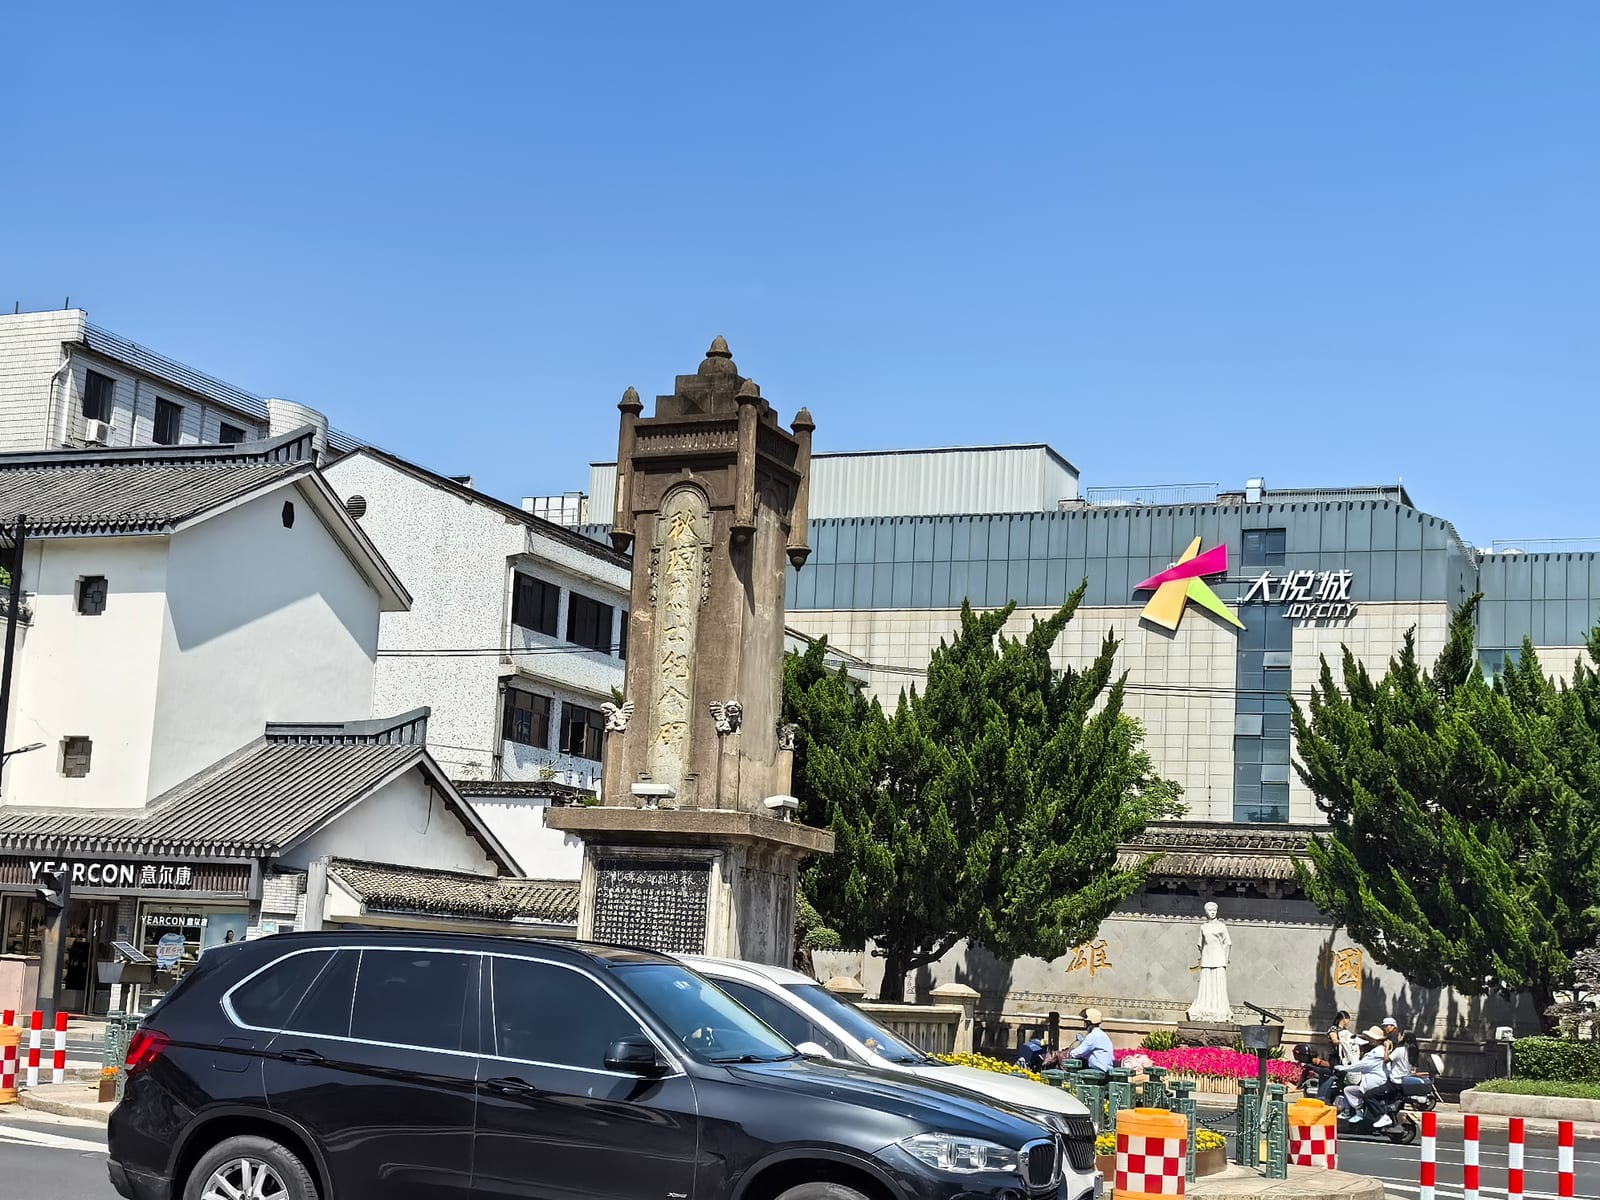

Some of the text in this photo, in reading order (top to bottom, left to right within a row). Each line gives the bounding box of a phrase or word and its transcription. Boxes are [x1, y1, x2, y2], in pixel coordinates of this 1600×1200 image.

[1243, 569, 1353, 602] 大悦城
[141, 864, 192, 886] 意尔康
[141, 915, 185, 926] YEARCON
